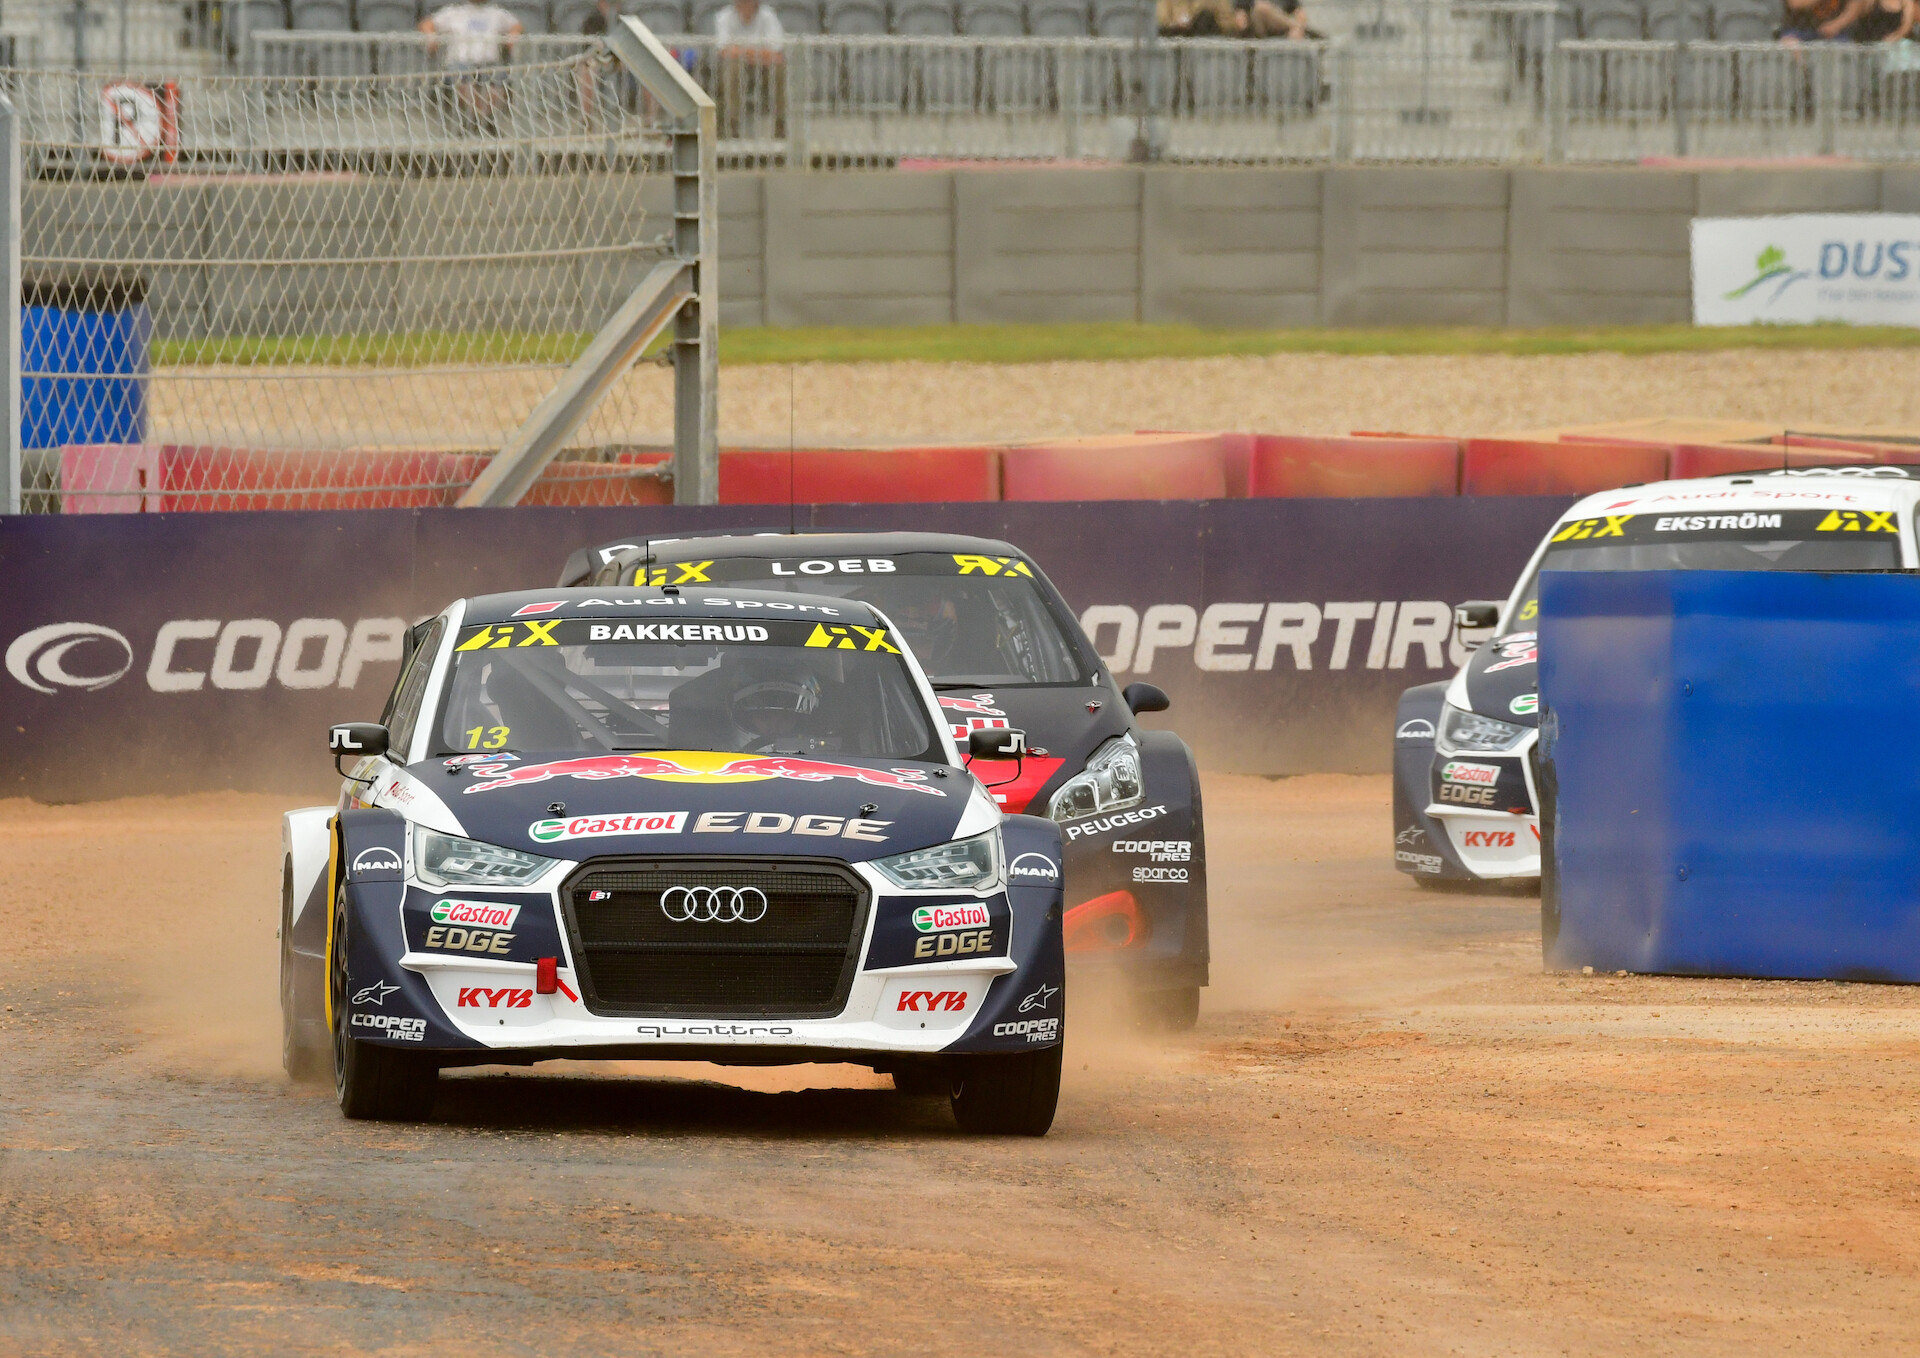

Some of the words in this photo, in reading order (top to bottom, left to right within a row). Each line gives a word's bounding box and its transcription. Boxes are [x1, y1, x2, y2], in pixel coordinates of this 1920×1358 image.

[1753, 490, 1858, 503] Sport
[1654, 512, 1782, 532] EKSTRÖM
[771, 558, 897, 575] LOEB
[577, 597, 687, 607] Audi
[703, 597, 840, 616] Sport
[1518, 599, 1538, 620] 5
[589, 624, 769, 642] BAKKERUD
[147, 617, 437, 693] COOP
[465, 726, 510, 749] 13
[1453, 765, 1496, 783] Castrol
[1439, 783, 1498, 805] EDGE
[568, 814, 676, 836] Castrol
[691, 811, 895, 843] EDGE
[1065, 805, 1168, 840] PEUGEOT
[1111, 840, 1192, 853] COOPER
[1464, 831, 1515, 847] KYB
[357, 861, 399, 870] MAN
[1149, 852, 1191, 862] TIRES
[1395, 851, 1443, 866] COOPER
[1014, 867, 1054, 877] MAN
[1132, 867, 1189, 881] sparco
[1417, 863, 1442, 874] TIRES
[449, 902, 513, 927] Castrol
[933, 906, 988, 928] Castrol
[425, 926, 518, 955] EDGE
[914, 929, 993, 958] EDGE
[457, 987, 534, 1008] KYB
[896, 991, 968, 1012] KYB
[351, 1013, 428, 1033] COOPER
[636, 1024, 793, 1038] quattro
[993, 1017, 1059, 1037] COOPER
[385, 1028, 425, 1042] TIRES
[1026, 1030, 1057, 1043] TIRES
